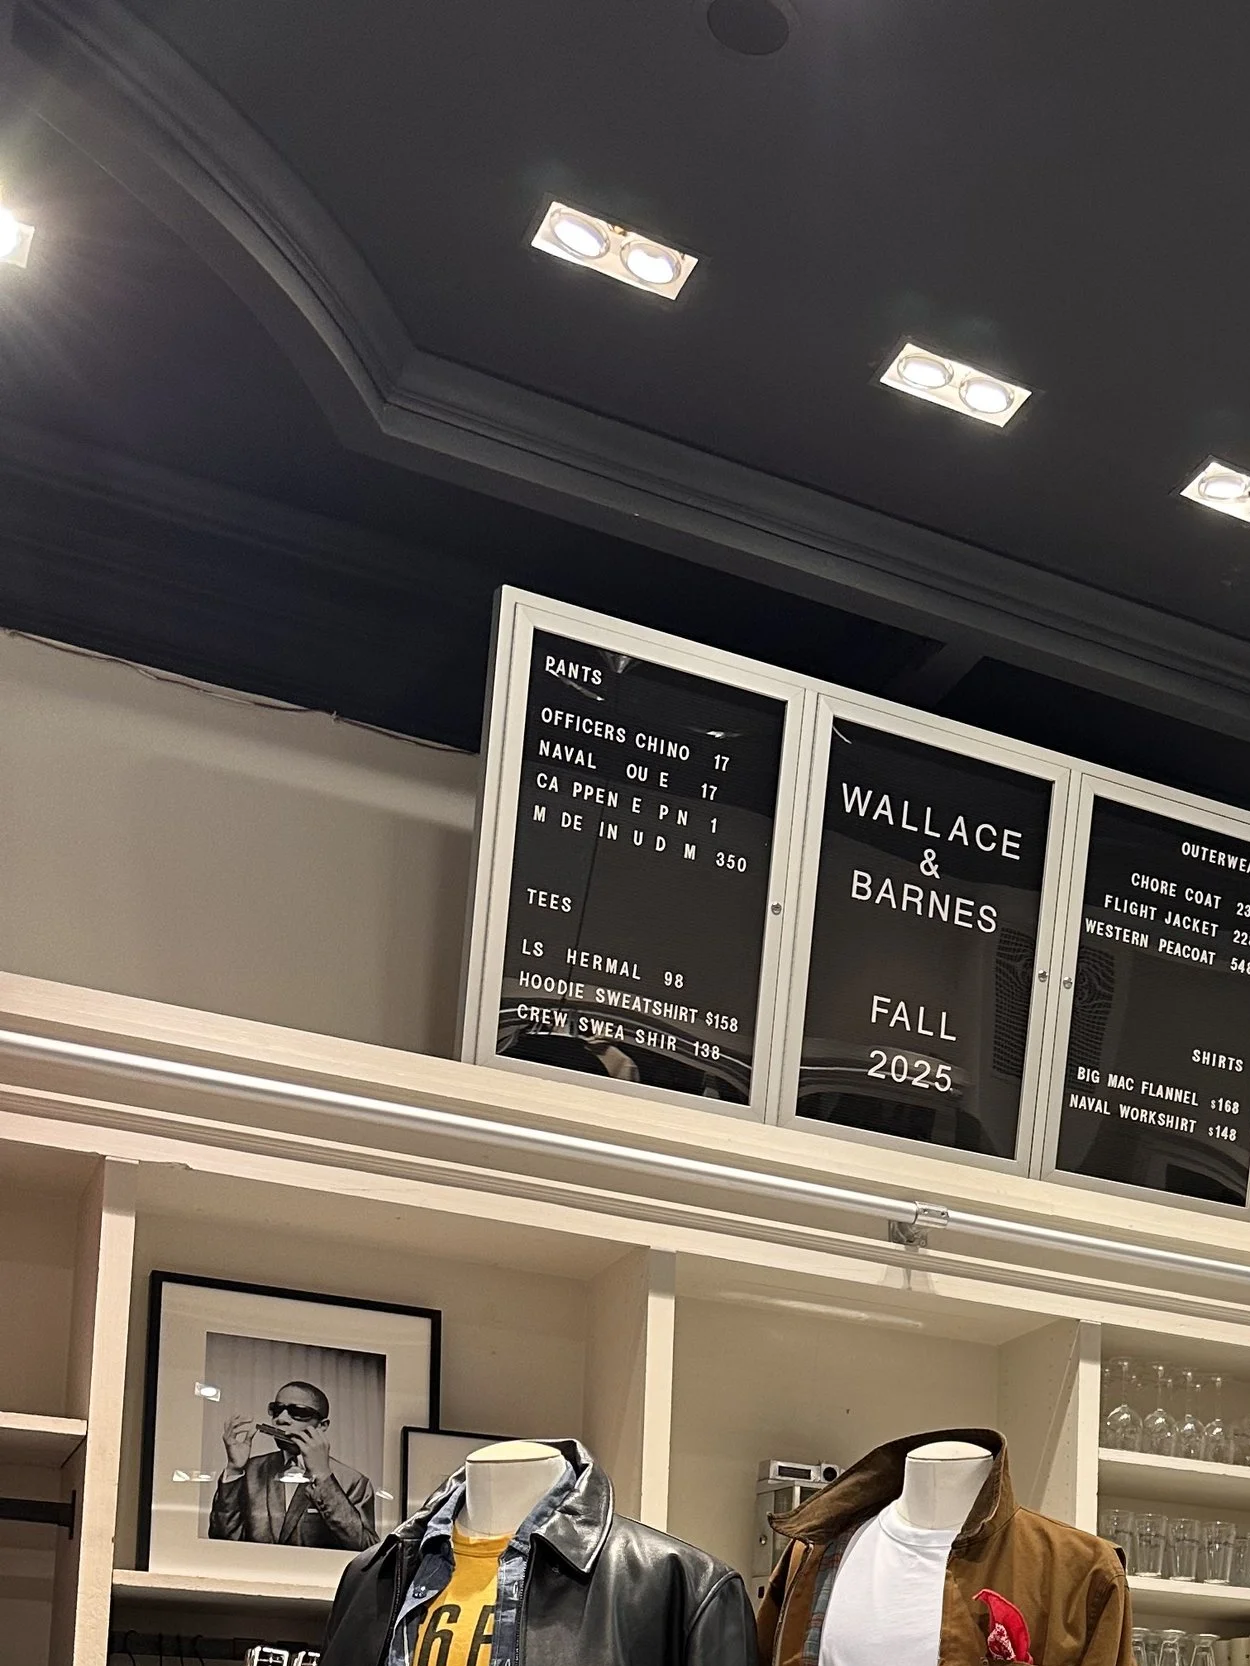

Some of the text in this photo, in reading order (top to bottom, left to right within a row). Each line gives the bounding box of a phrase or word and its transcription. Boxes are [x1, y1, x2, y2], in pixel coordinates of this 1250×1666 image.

[545, 655, 602, 685] PANTS
[541, 707, 730, 772] OFFICERS CHINO 17
[538, 739, 597, 770] NAVAL
[701, 782, 718, 801] 17
[841, 782, 1022, 860] WALLACE
[599, 820, 618, 841] IN
[716, 851, 747, 873] 350
[919, 848, 941, 880] &
[527, 888, 573, 913] TEES
[851, 869, 998, 933] BARNES
[1131, 872, 1178, 898] CHORE
[1185, 887, 1222, 910] COAT
[1104, 894, 1158, 921] FLIGHT
[1164, 911, 1220, 938] JACKET
[521, 938, 684, 989] LS HERMAL 98
[1084, 918, 1149, 949] WESTERN
[1158, 938, 1216, 966] PEACOAT
[519, 970, 738, 1033] HOODIE SWEATSHIRT $158
[870, 994, 957, 1042] FALL
[517, 1003, 568, 1028] CREW
[693, 1040, 721, 1061] 138
[867, 1050, 952, 1092] 2025
[1191, 1049, 1244, 1073] SHIRTS
[1077, 1066, 1240, 1115] BIG MAC FLANNEL $168
[1069, 1094, 1237, 1142] NAVAL WORKSHIRT $148
